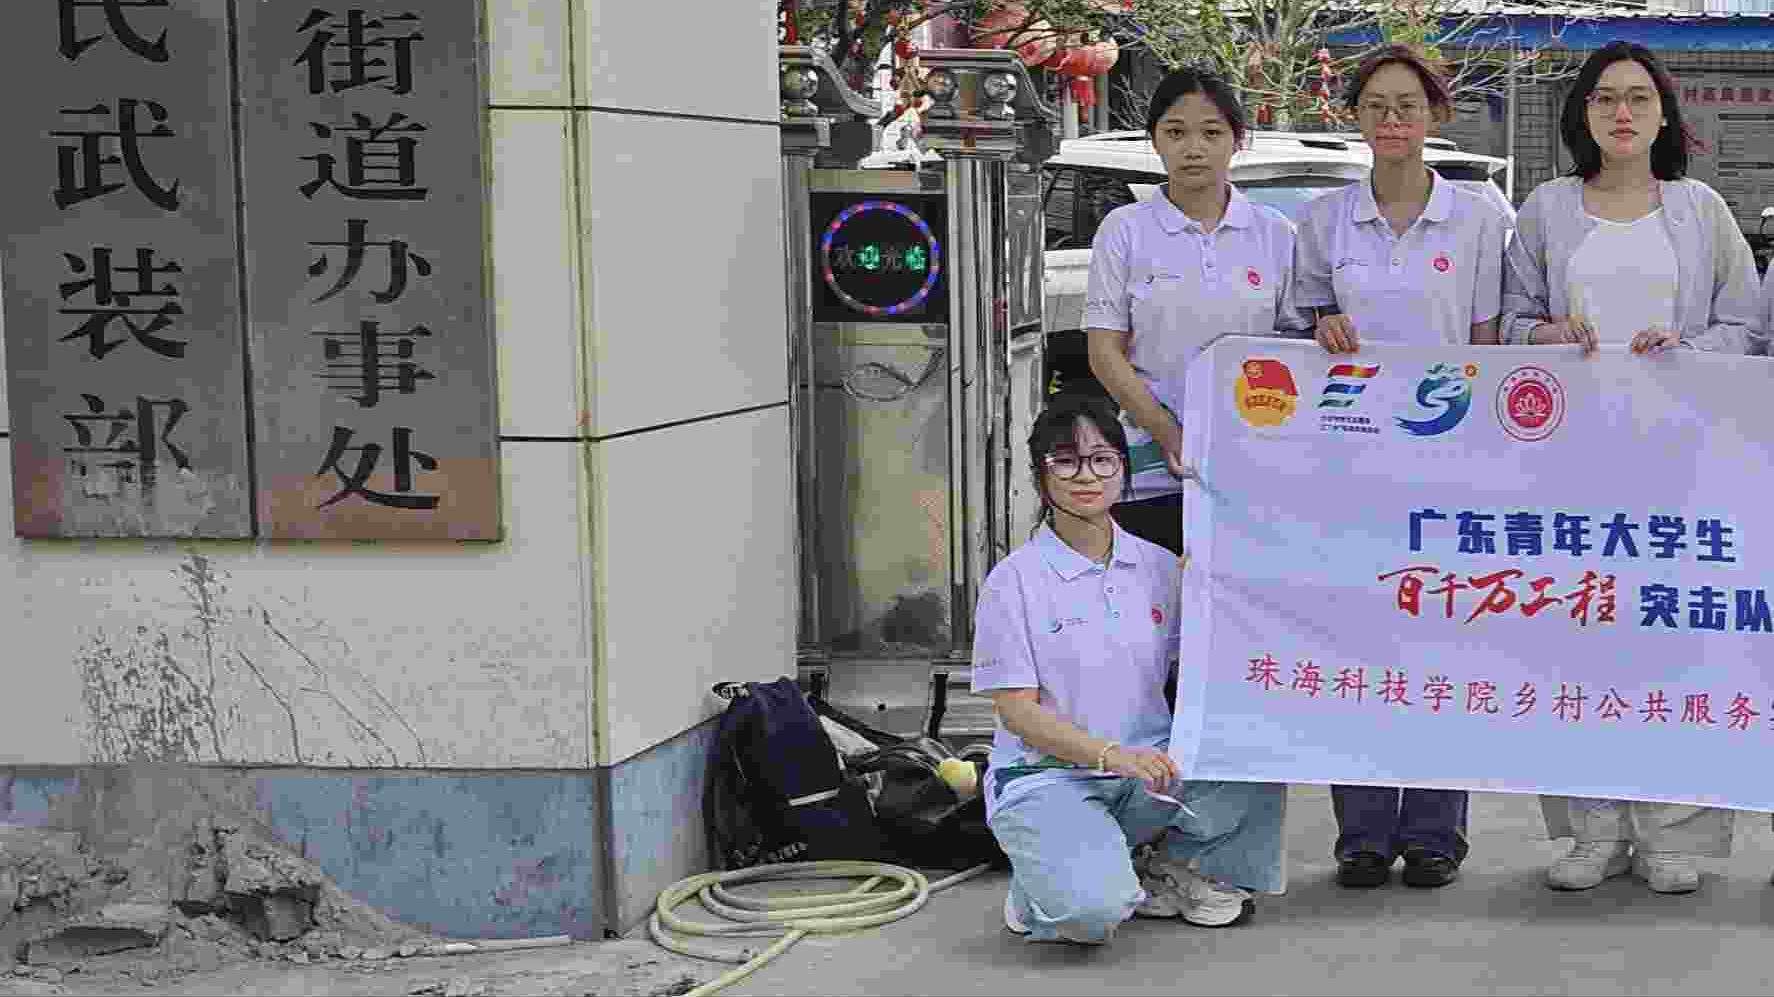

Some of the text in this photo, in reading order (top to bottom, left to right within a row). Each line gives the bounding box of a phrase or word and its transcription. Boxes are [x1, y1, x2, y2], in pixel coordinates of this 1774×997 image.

[1409, 509, 1737, 562] 广东青年大学生
[1377, 566, 1774, 633] 百千万工程 突击队
